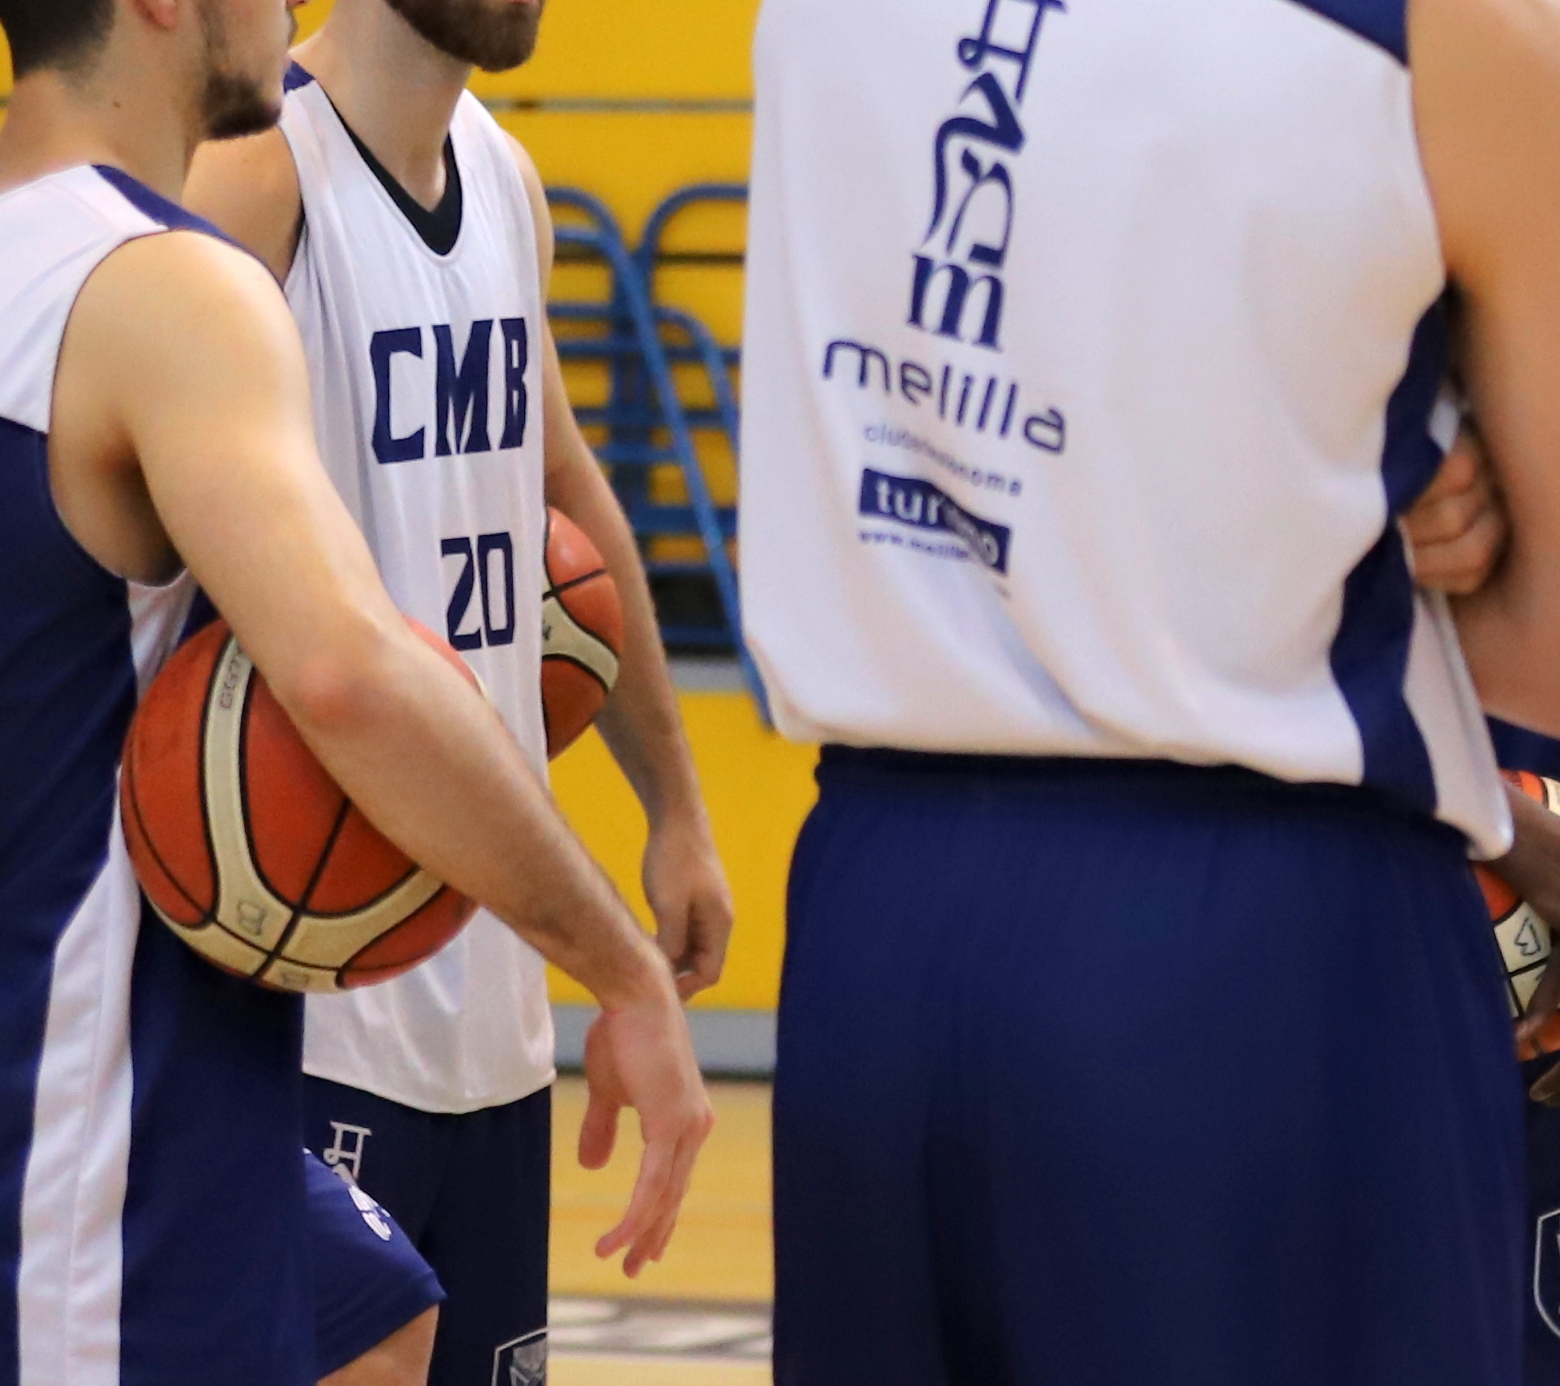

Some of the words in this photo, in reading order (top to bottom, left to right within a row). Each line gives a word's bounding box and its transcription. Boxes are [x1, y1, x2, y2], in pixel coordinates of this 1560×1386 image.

[369, 316, 529, 465] CMB
[822, 338, 1068, 456] melilla
[439, 531, 516, 651] 20
